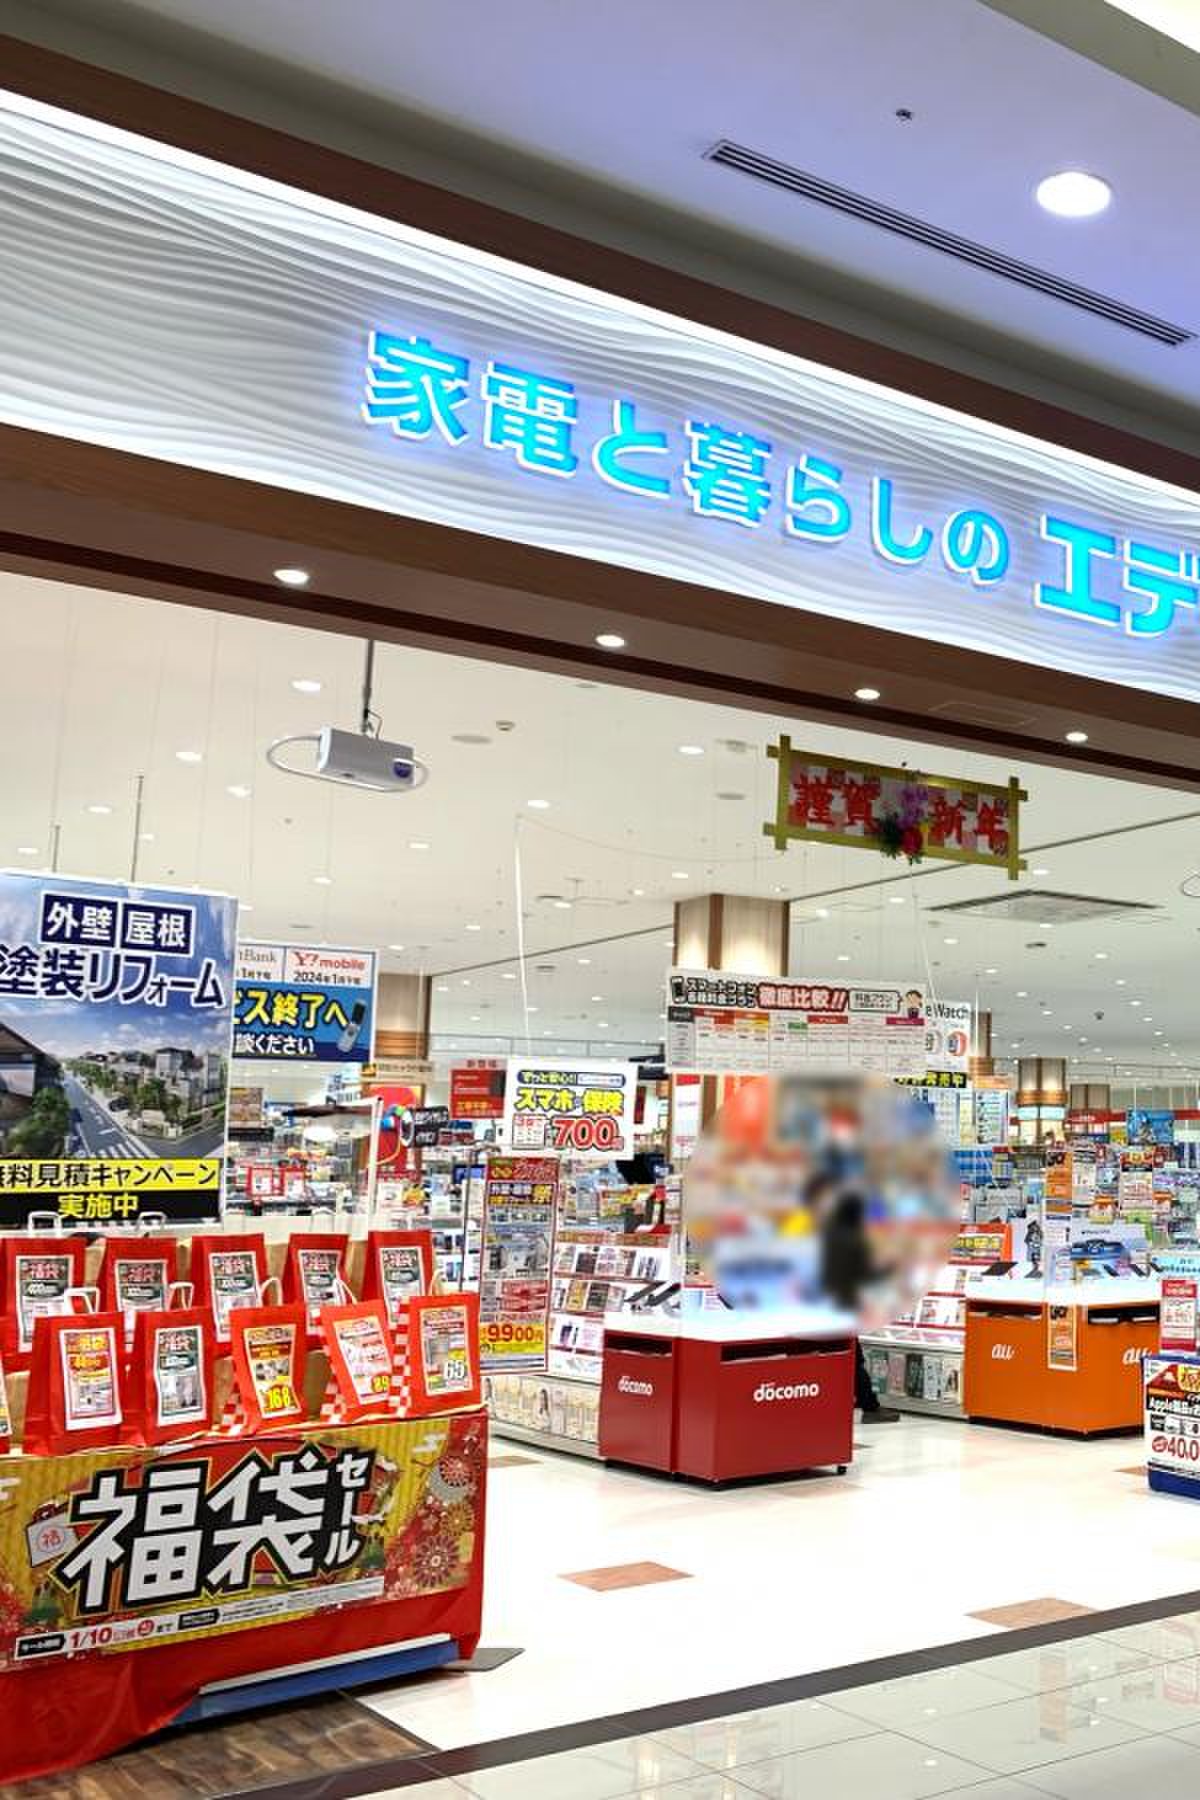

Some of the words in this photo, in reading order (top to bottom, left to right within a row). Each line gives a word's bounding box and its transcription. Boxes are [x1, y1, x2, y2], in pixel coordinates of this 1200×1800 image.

[362, 330, 1010, 585] 家電と暮らしの
[46, 902, 114, 943] 外壁
[125, 910, 187, 949] 屋根
[0, 945, 226, 1007] 塗装リフォーム
[58, 1193, 139, 1219] 実施中
[991, 1343, 1015, 1360] au
[618, 1376, 653, 1396] docomo
[753, 1381, 819, 1402] docomo
[62, 1452, 329, 1608] 福袋
[324, 1452, 368, 1566] セール
[70, 1626, 113, 1649] 1/10
